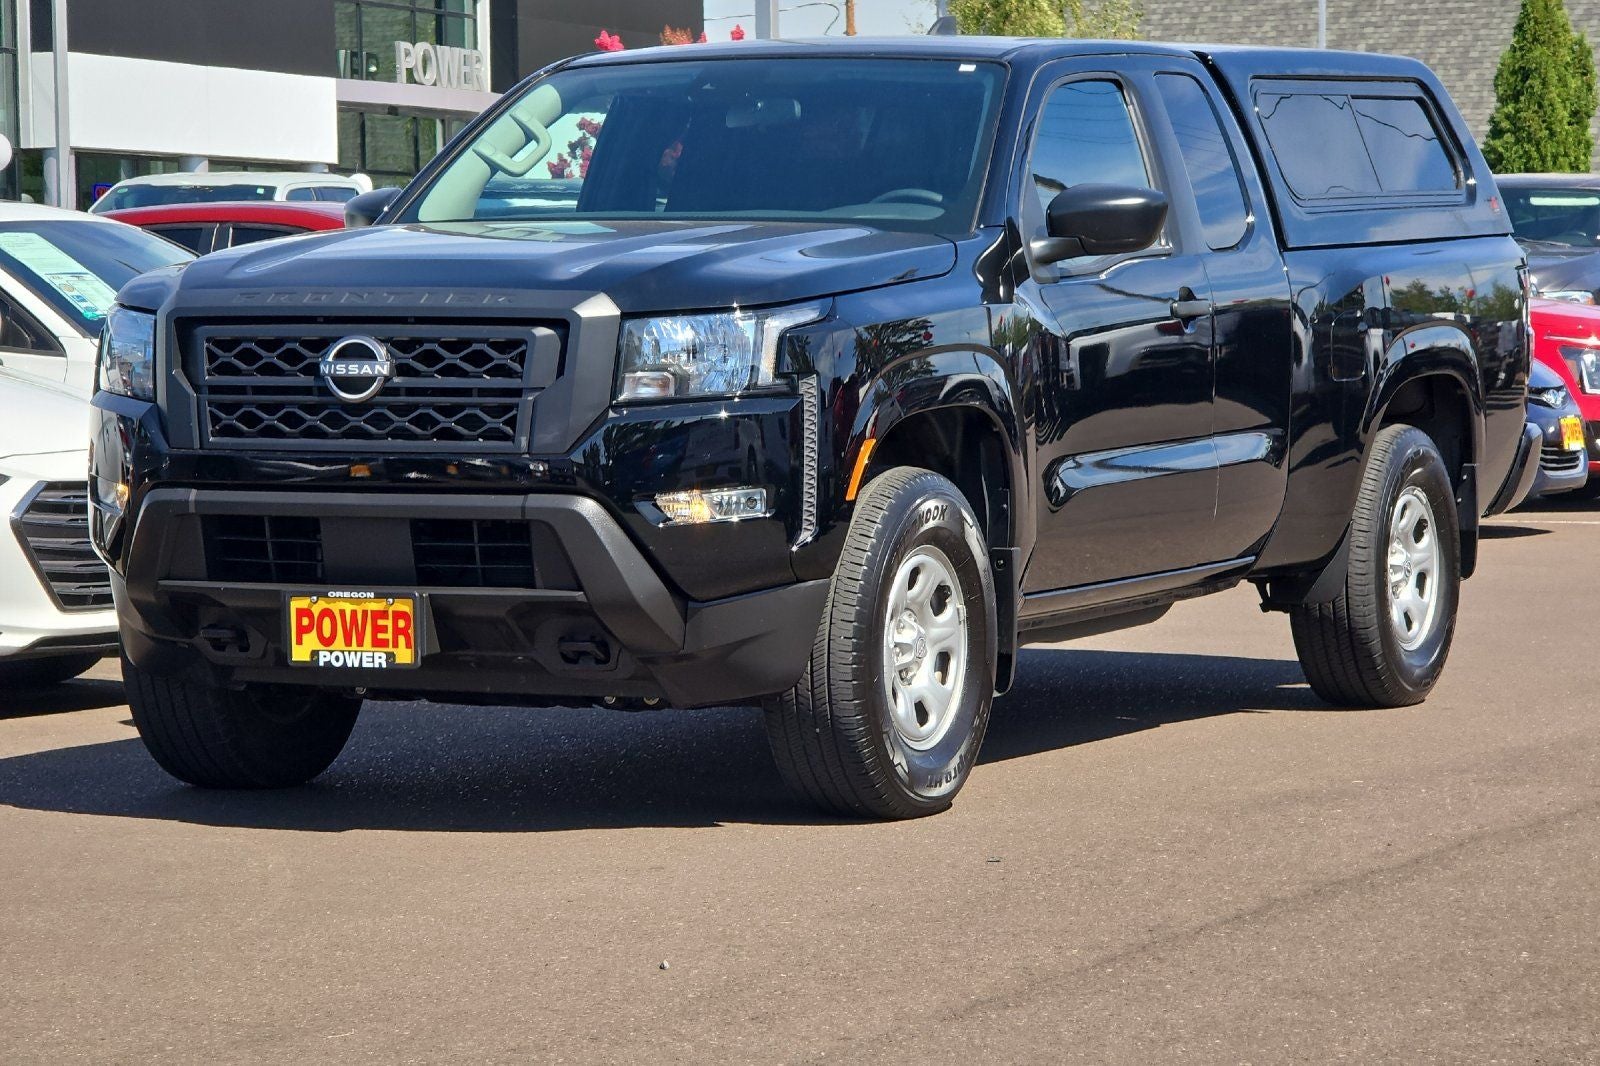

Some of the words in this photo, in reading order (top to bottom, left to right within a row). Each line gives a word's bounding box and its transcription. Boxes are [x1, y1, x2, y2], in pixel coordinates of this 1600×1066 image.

[395, 41, 484, 91] POWER
[320, 364, 388, 375] NISSAN
[328, 591, 375, 599] OREGON
[295, 607, 412, 649] POWER
[318, 651, 387, 668] POWER
